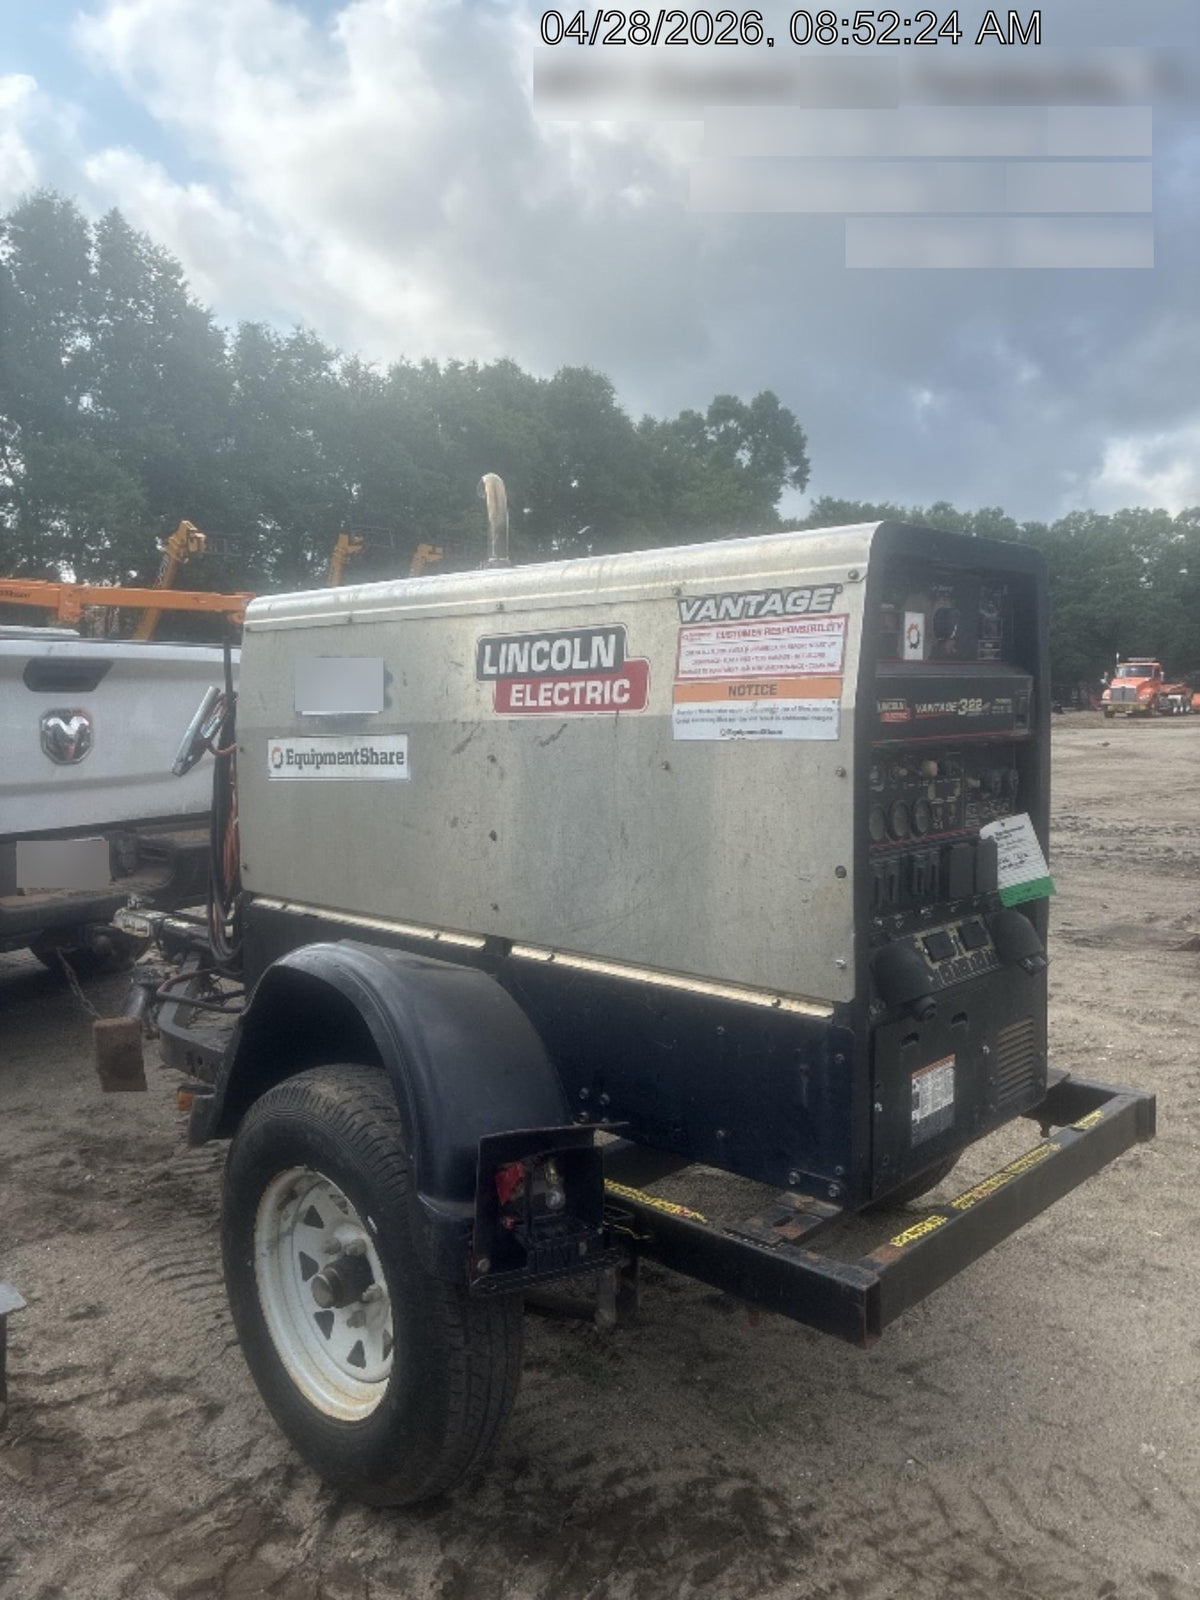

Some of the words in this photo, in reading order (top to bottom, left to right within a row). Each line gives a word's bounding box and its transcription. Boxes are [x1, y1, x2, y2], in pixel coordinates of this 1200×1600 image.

[678, 586, 836, 623] VANTAGE
[483, 634, 616, 675] LINCOLN
[509, 679, 630, 707] ELECTRIC
[728, 684, 778, 697] NOTICE
[285, 747, 405, 770] EquipmentShare
